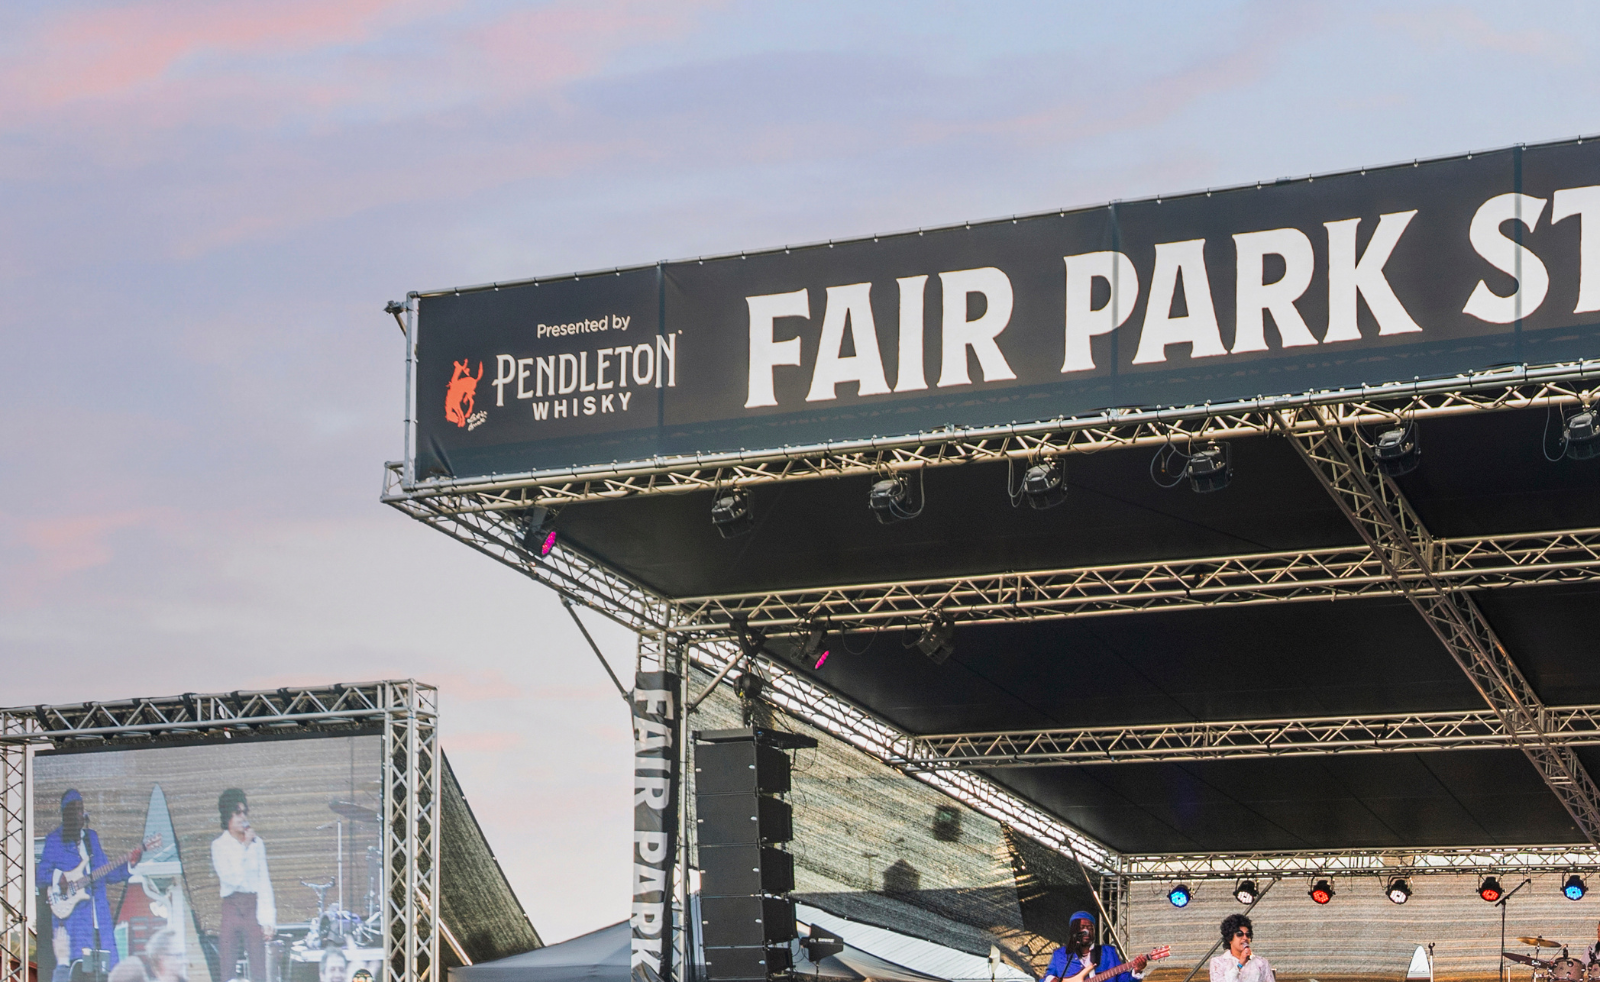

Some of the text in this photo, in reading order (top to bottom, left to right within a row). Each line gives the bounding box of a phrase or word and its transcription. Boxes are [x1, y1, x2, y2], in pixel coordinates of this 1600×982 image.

[537, 314, 631, 339] Presented by
[744, 267, 1018, 408] FAIR
[1061, 209, 1423, 373] PARK
[492, 333, 677, 407] PENDLETON
[532, 391, 632, 421] WHISKY
[634, 687, 674, 810] FAIR
[630, 831, 668, 975] PARK
